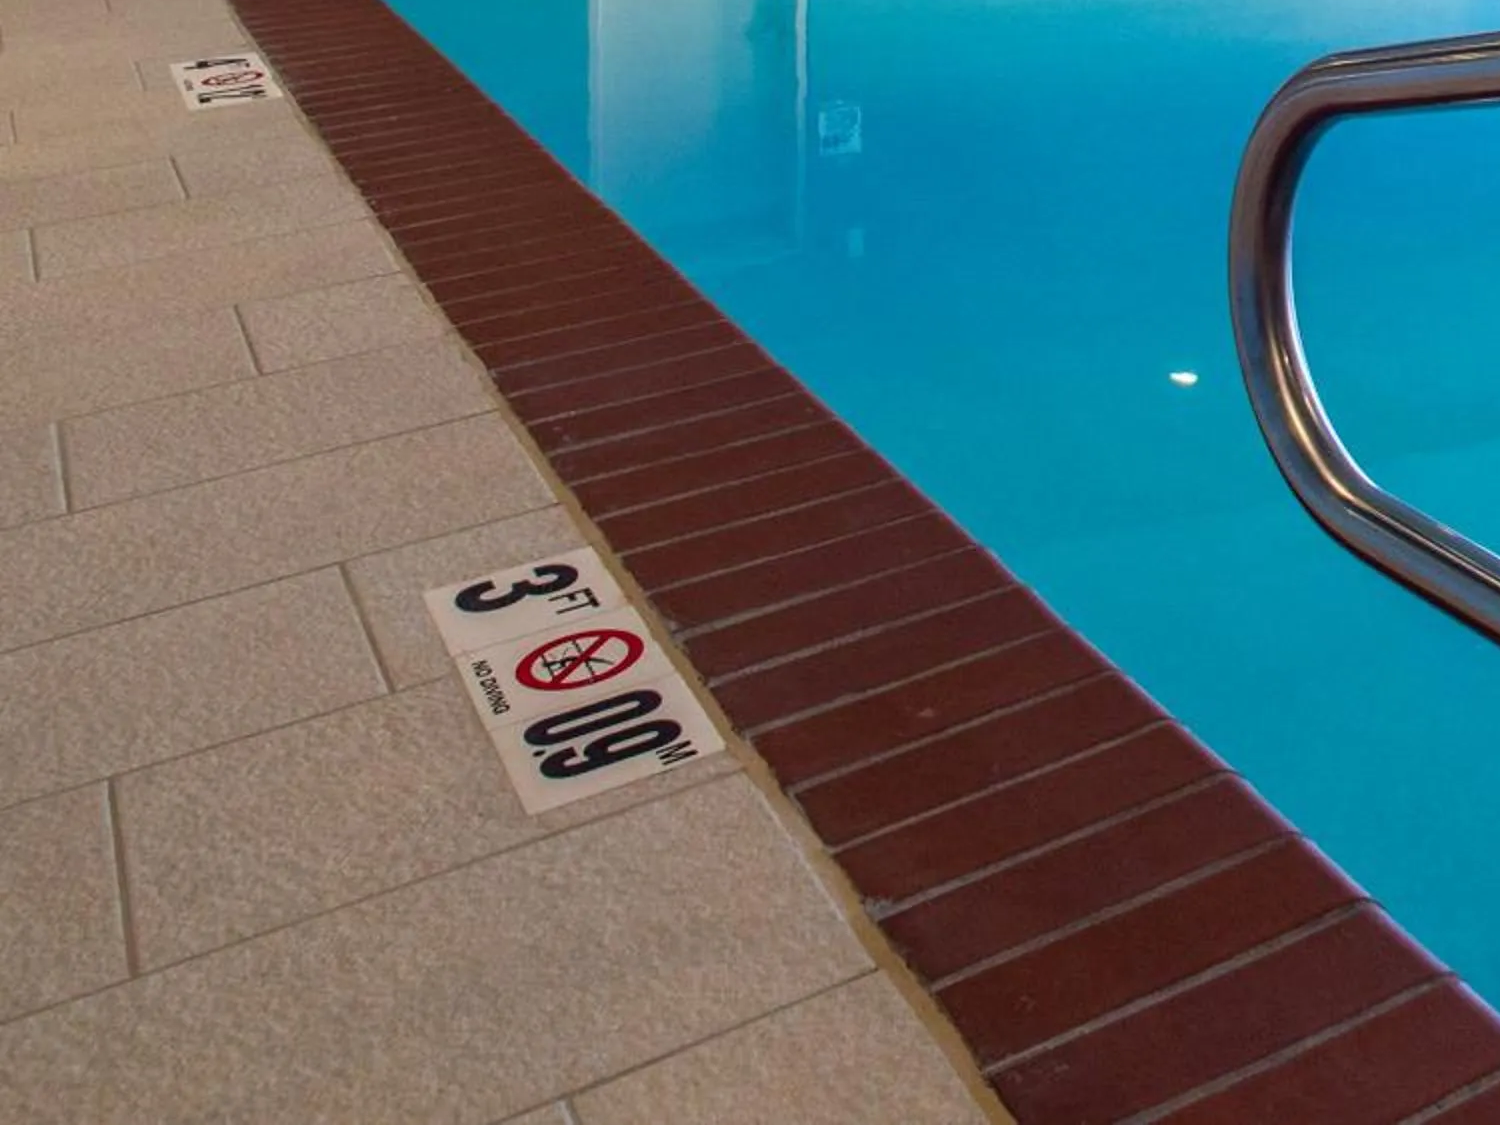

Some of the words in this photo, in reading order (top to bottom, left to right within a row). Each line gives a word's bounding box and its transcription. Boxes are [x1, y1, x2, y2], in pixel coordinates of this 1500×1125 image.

[455, 564, 579, 613] 3
[548, 587, 600, 615] FT
[472, 660, 491, 679] NO
[480, 673, 510, 715] DIVING
[655, 740, 698, 766] M
